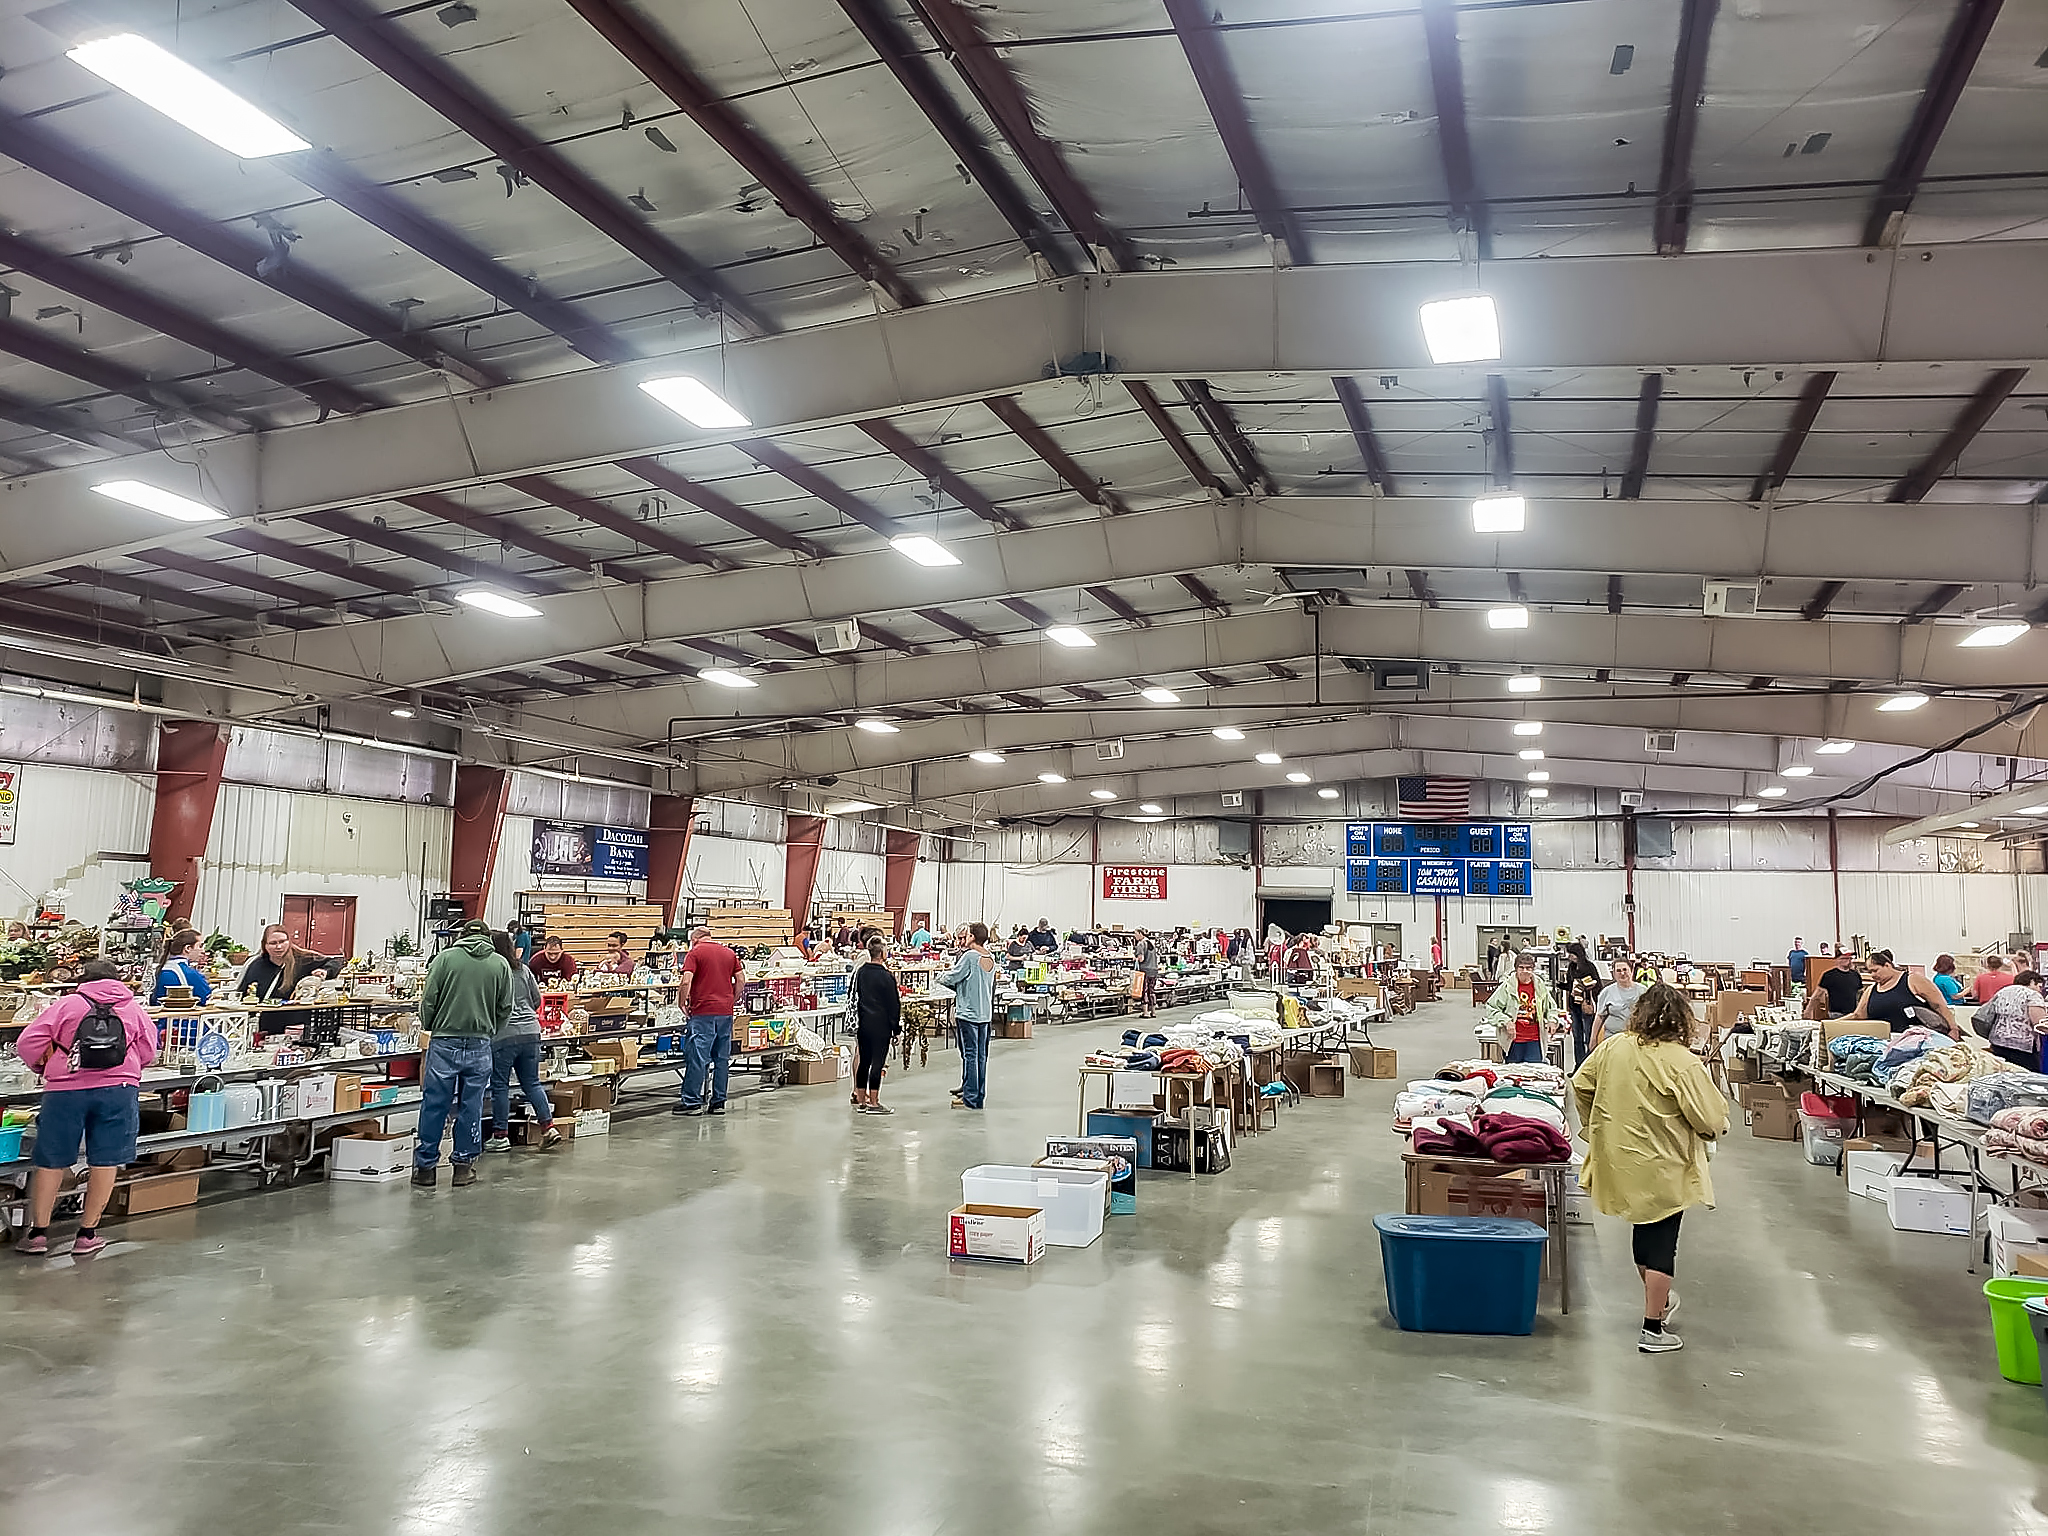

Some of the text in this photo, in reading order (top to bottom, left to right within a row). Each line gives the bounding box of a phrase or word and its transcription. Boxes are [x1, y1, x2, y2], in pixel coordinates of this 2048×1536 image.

[1383, 826, 1403, 835] HOME
[1469, 827, 1494, 836] GUEST
[609, 845, 635, 859] BANK
[1105, 867, 1165, 878] Firestone
[1112, 876, 1158, 886] FARM
[1416, 876, 1459, 887] CASANOVA
[1110, 885, 1160, 895] TIRES
[1109, 1144, 1135, 1152] INTEX
